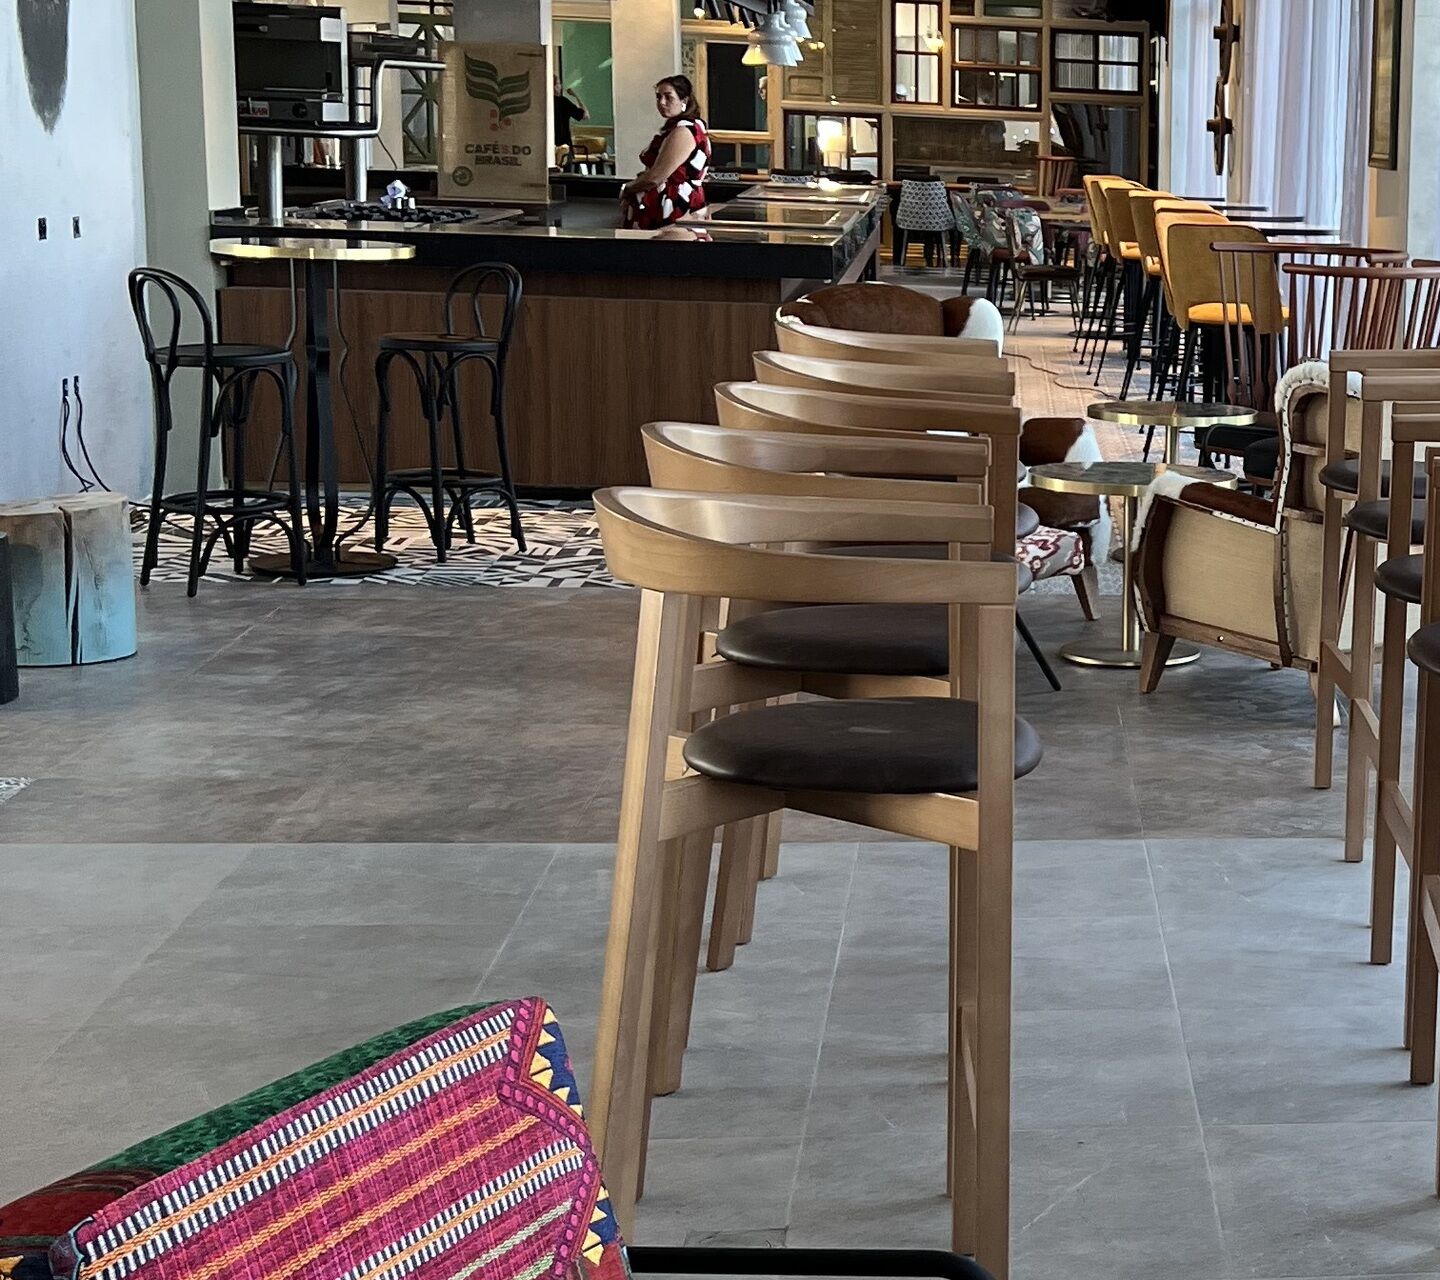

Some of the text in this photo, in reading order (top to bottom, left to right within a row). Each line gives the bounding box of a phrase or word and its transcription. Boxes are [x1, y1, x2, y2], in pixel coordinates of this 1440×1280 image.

[464, 141, 532, 156] CAFÉS DO
[475, 155, 522, 166] BRASIL
